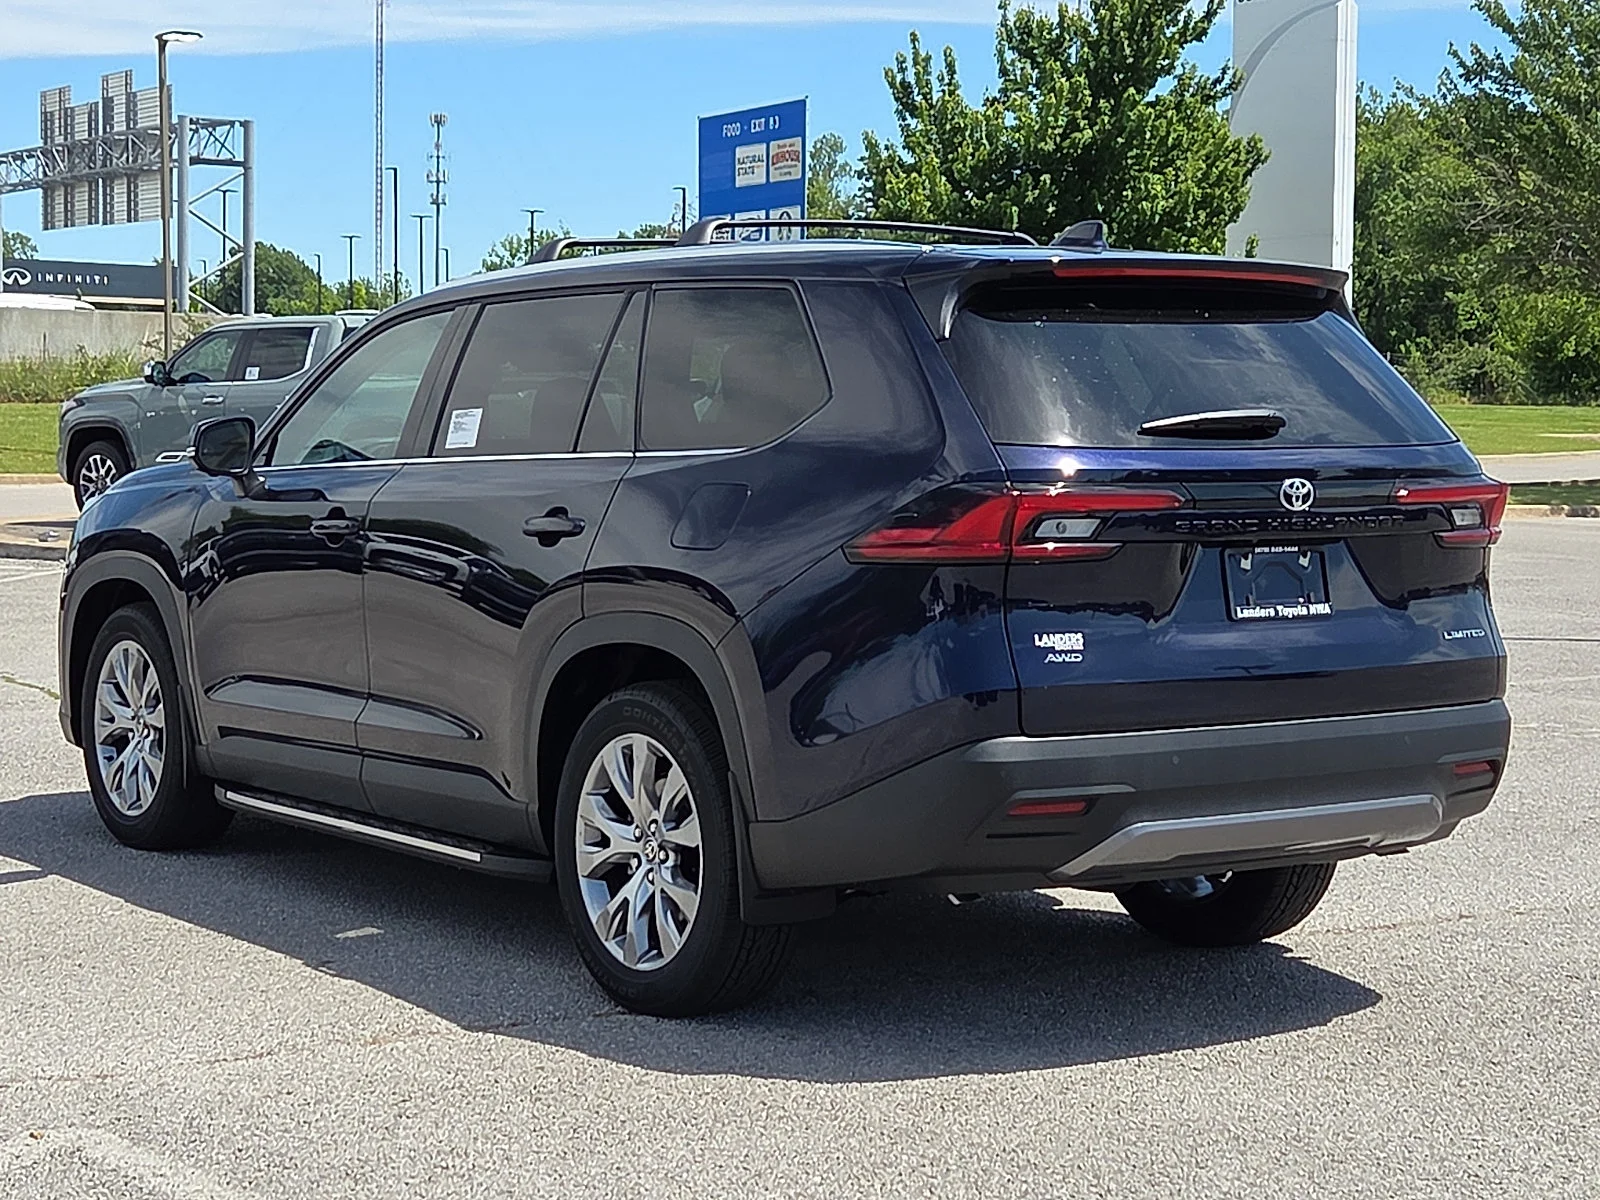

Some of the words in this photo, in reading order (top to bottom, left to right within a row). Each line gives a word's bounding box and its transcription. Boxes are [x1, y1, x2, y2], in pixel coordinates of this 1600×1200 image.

[722, 122, 741, 138] FOOD
[750, 117, 766, 133] EXIT
[37, 272, 109, 286] INFINITI
[1175, 520, 1259, 533] GRAND
[1266, 515, 1405, 532] HIGHLANDER
[1236, 605, 1276, 619] Landers
[1275, 603, 1308, 619] Toyota
[1033, 632, 1084, 648] LANDERS
[1443, 629, 1486, 640] LIMITED
[1043, 652, 1083, 664] AWD
